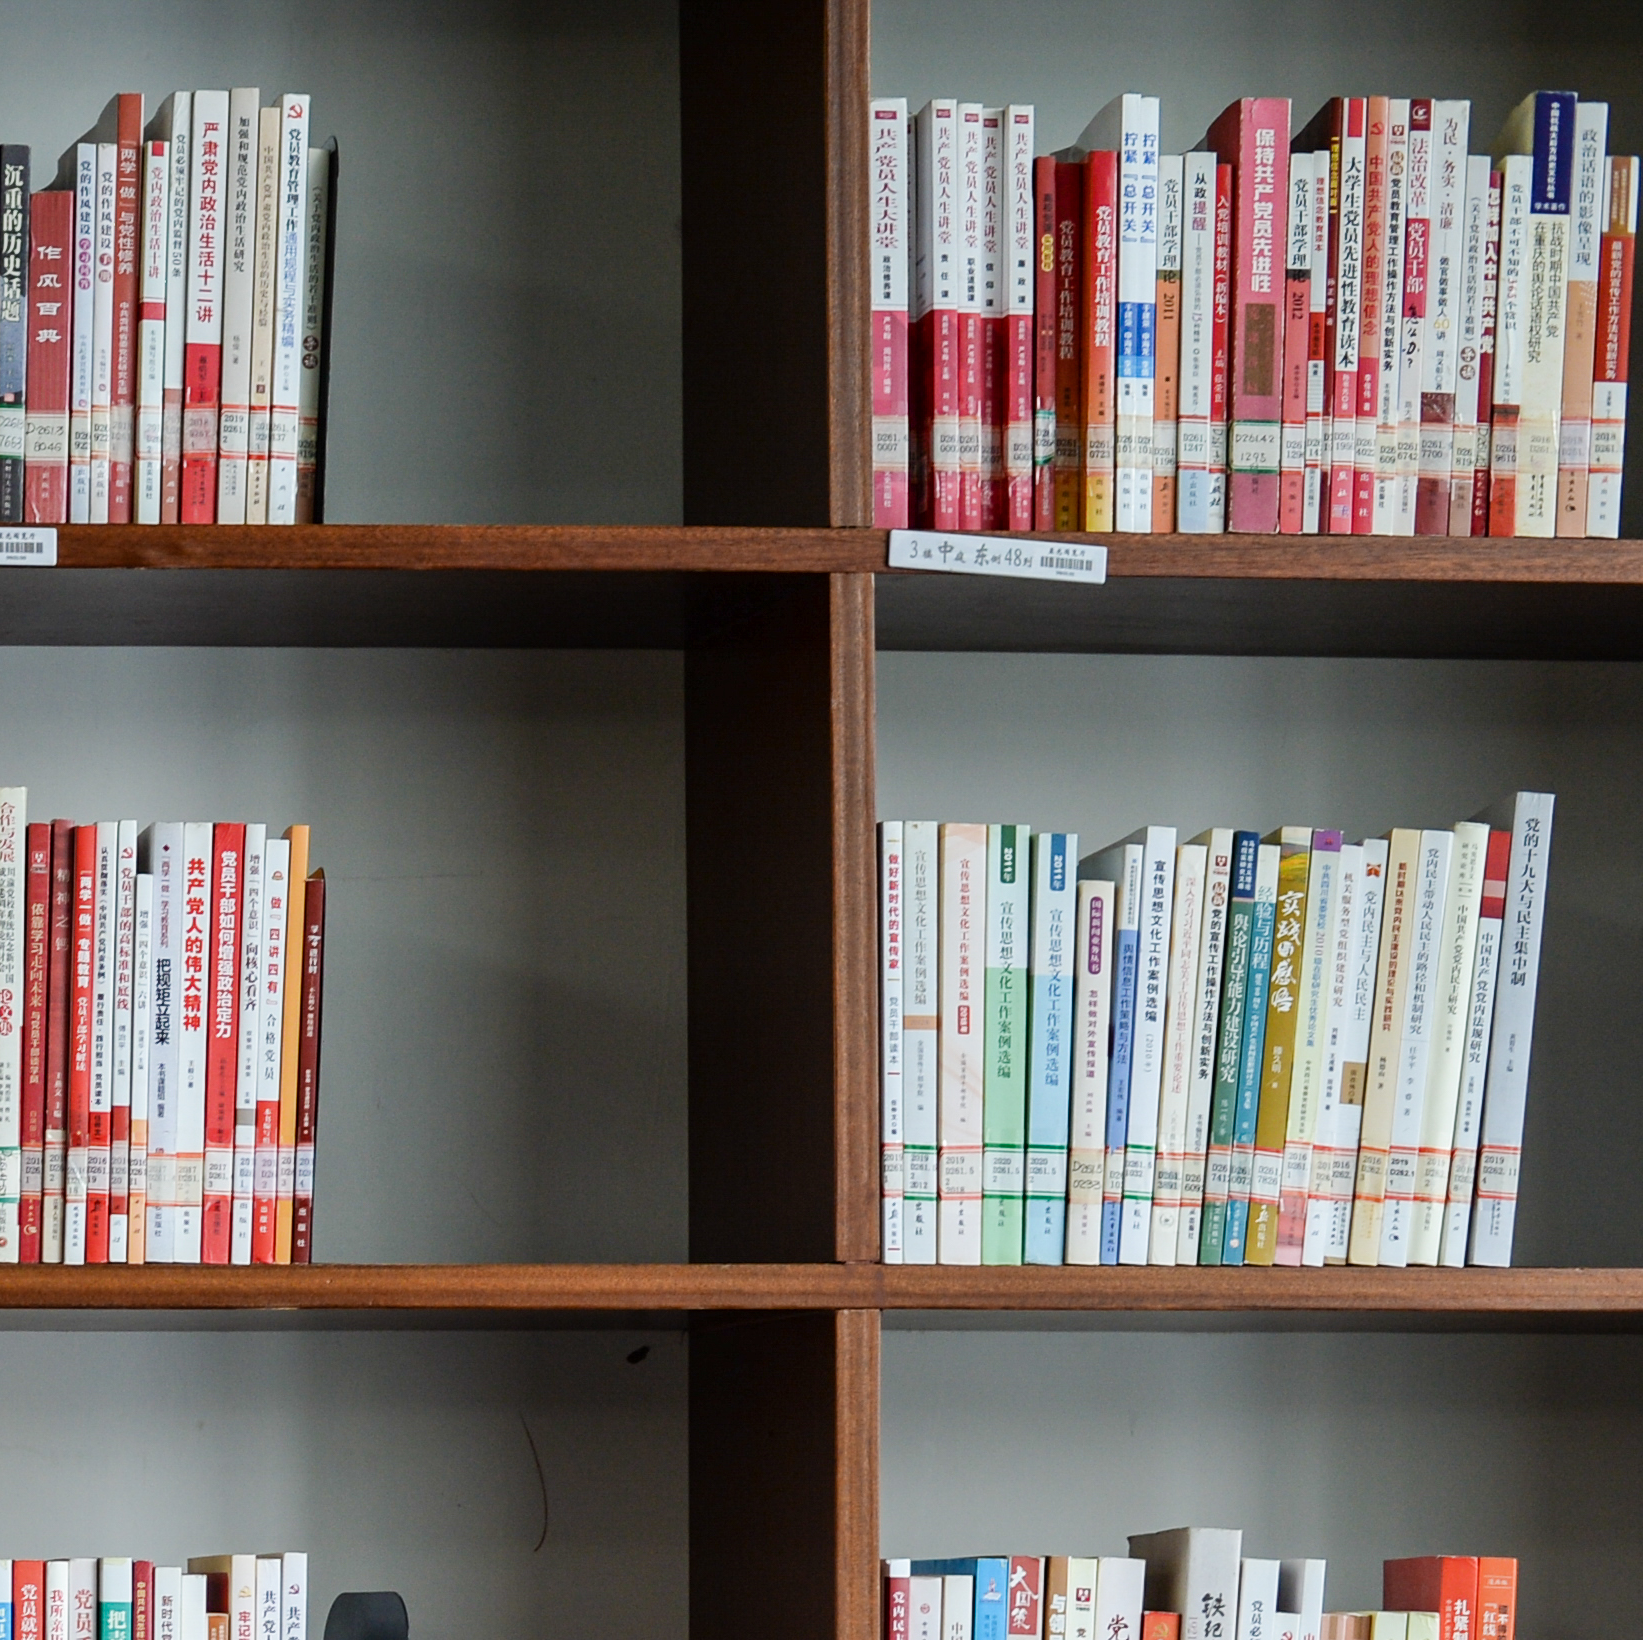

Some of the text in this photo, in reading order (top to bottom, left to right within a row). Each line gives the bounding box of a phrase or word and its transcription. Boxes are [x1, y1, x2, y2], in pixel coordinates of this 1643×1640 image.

[1, 163, 24, 323] 沉重的历史话题
[195, 122, 219, 324] 严肃党内政治生活十二讲
[183, 858, 205, 1031] 共产党人的伟大精神
